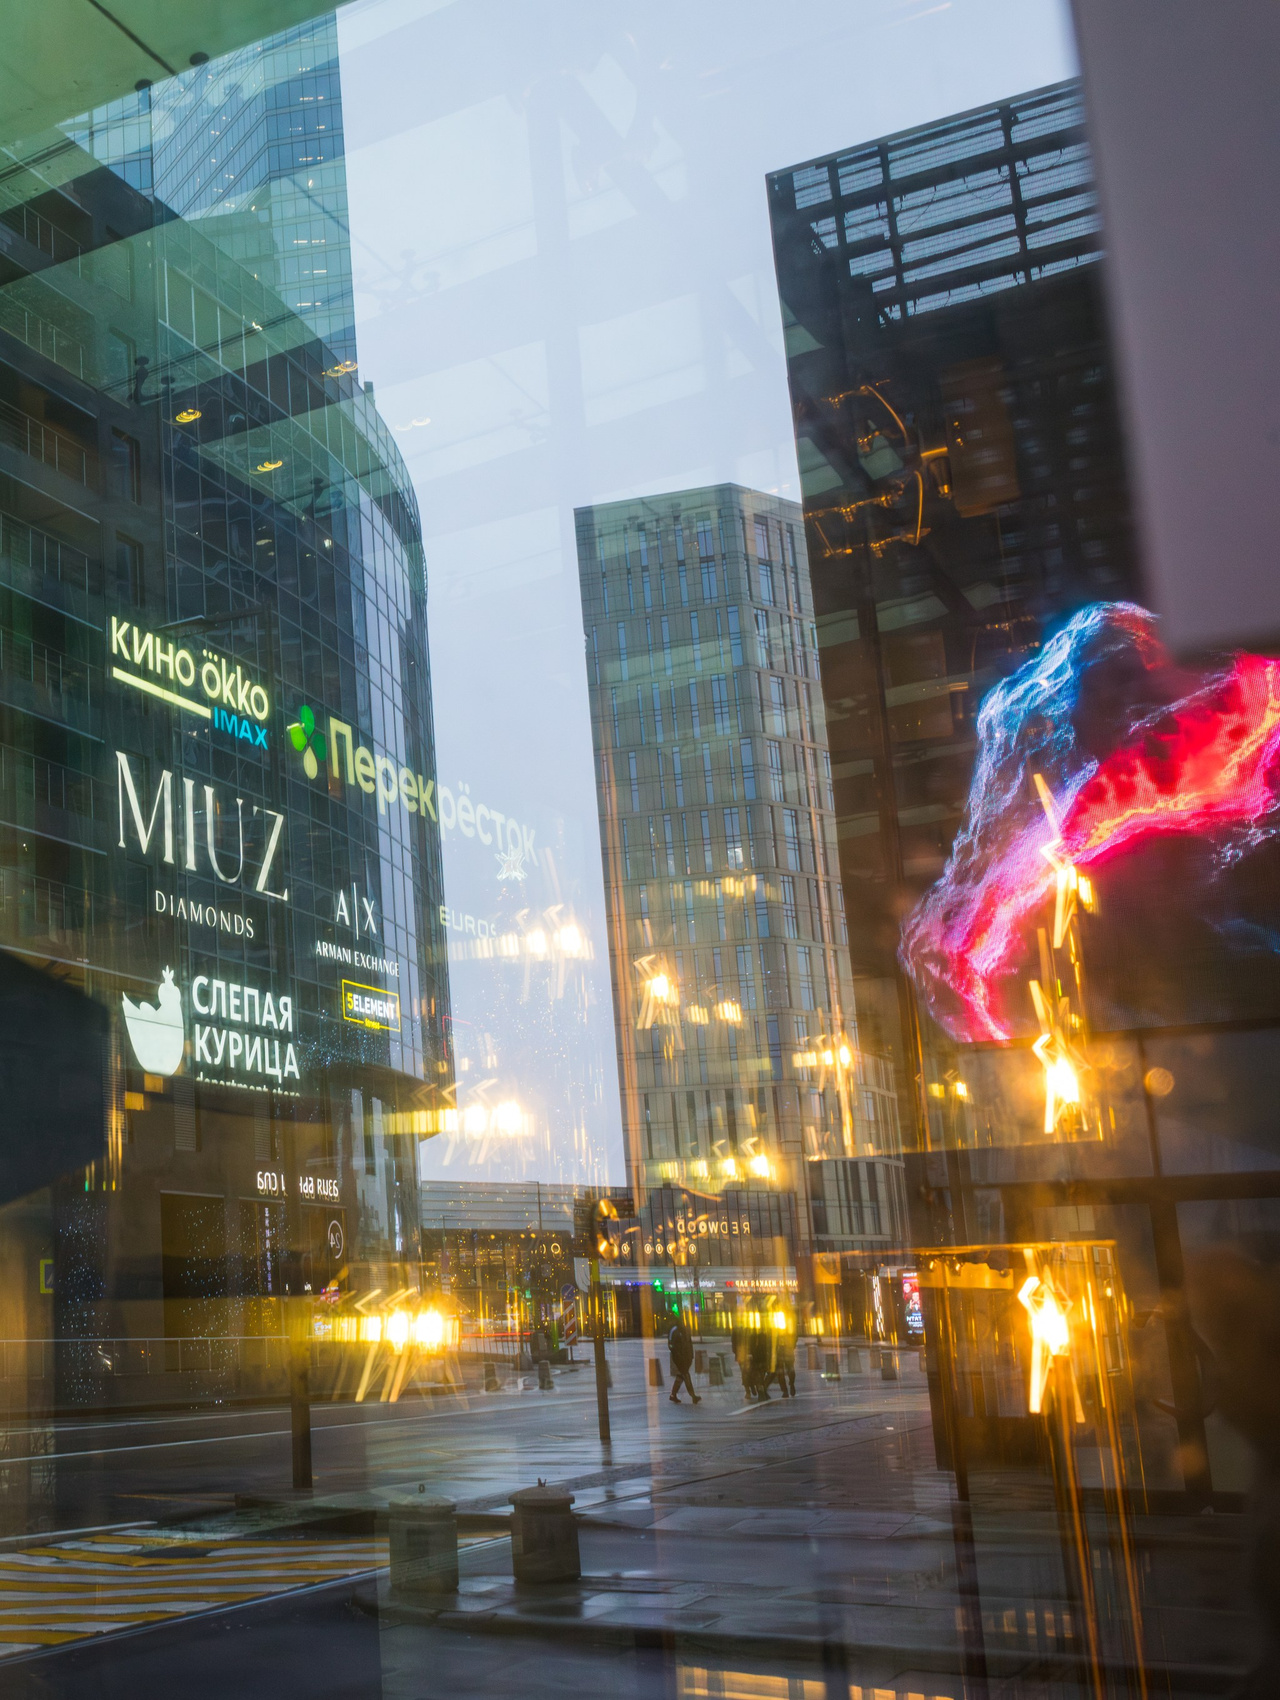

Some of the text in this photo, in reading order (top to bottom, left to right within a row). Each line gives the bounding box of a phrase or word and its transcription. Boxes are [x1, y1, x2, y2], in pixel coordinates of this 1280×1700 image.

[213, 706, 268, 751] IMAX
[329, 716, 539, 867] Перекрёсток
[115, 750, 289, 902] MIUZ
[154, 889, 255, 940] DIAMONDS
[315, 940, 400, 978] ARMANI EXCHANGE
[192, 975, 293, 1033] СЛЕПАЯ
[194, 1024, 301, 1084] КУРИЦА
